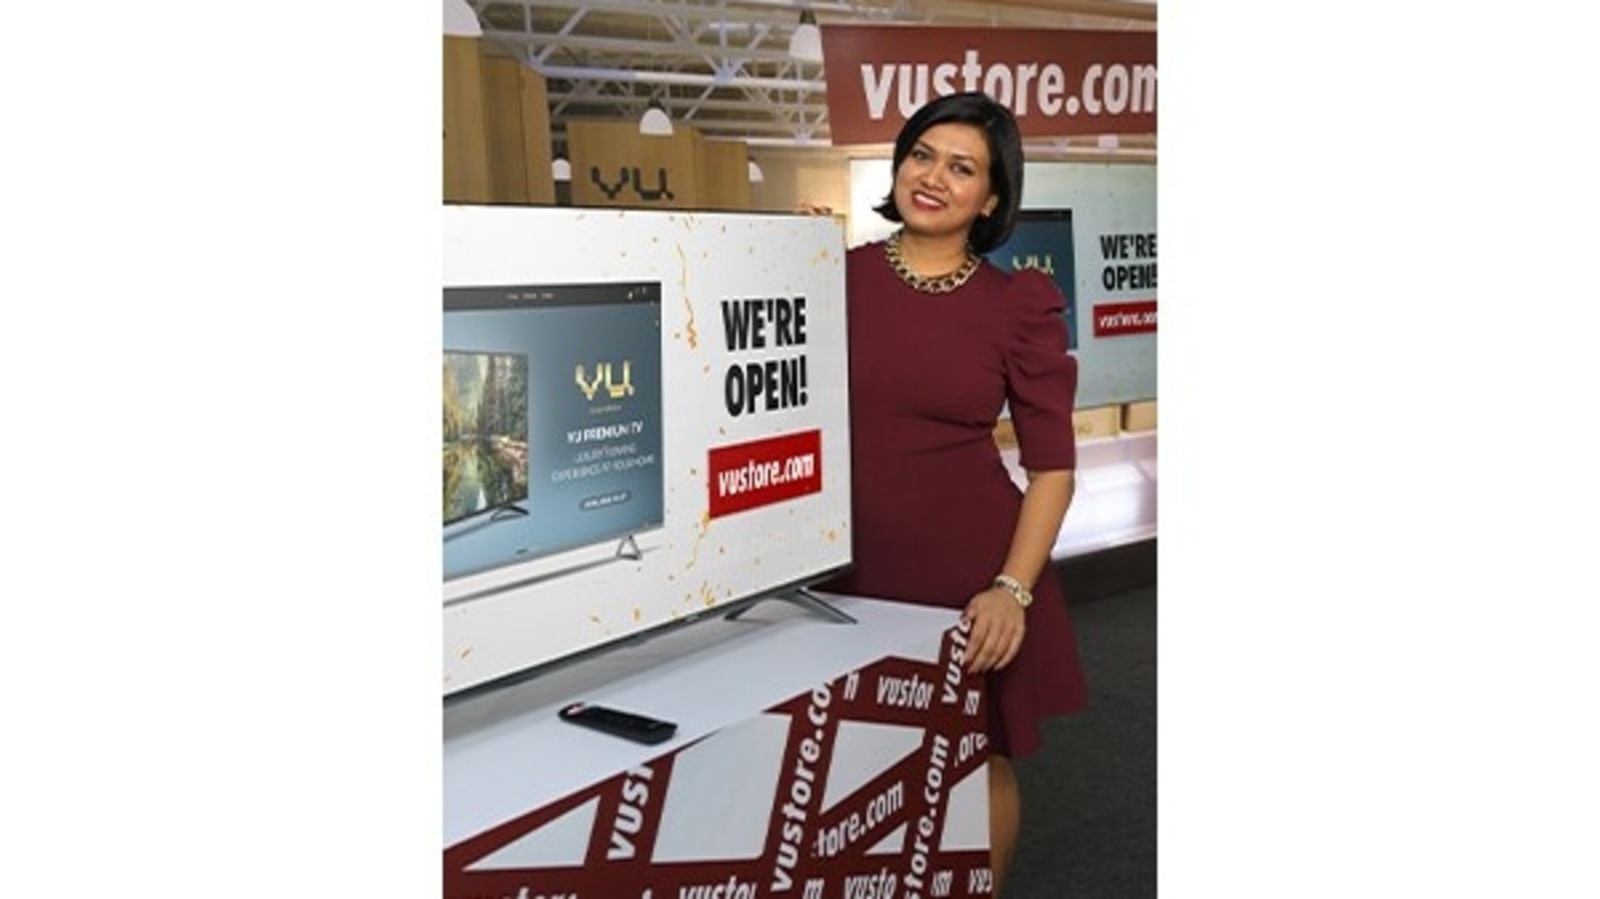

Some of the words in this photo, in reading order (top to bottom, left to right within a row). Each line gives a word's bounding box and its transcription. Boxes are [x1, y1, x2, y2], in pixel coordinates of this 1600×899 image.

[1100, 234, 1158, 260] WE'RE
[721, 297, 806, 351] WE'RE
[725, 355, 808, 417] OPEN!
[719, 453, 815, 497] vustore.com
[770, 680, 832, 892] vustore.co
[810, 781, 903, 857] tore.com
